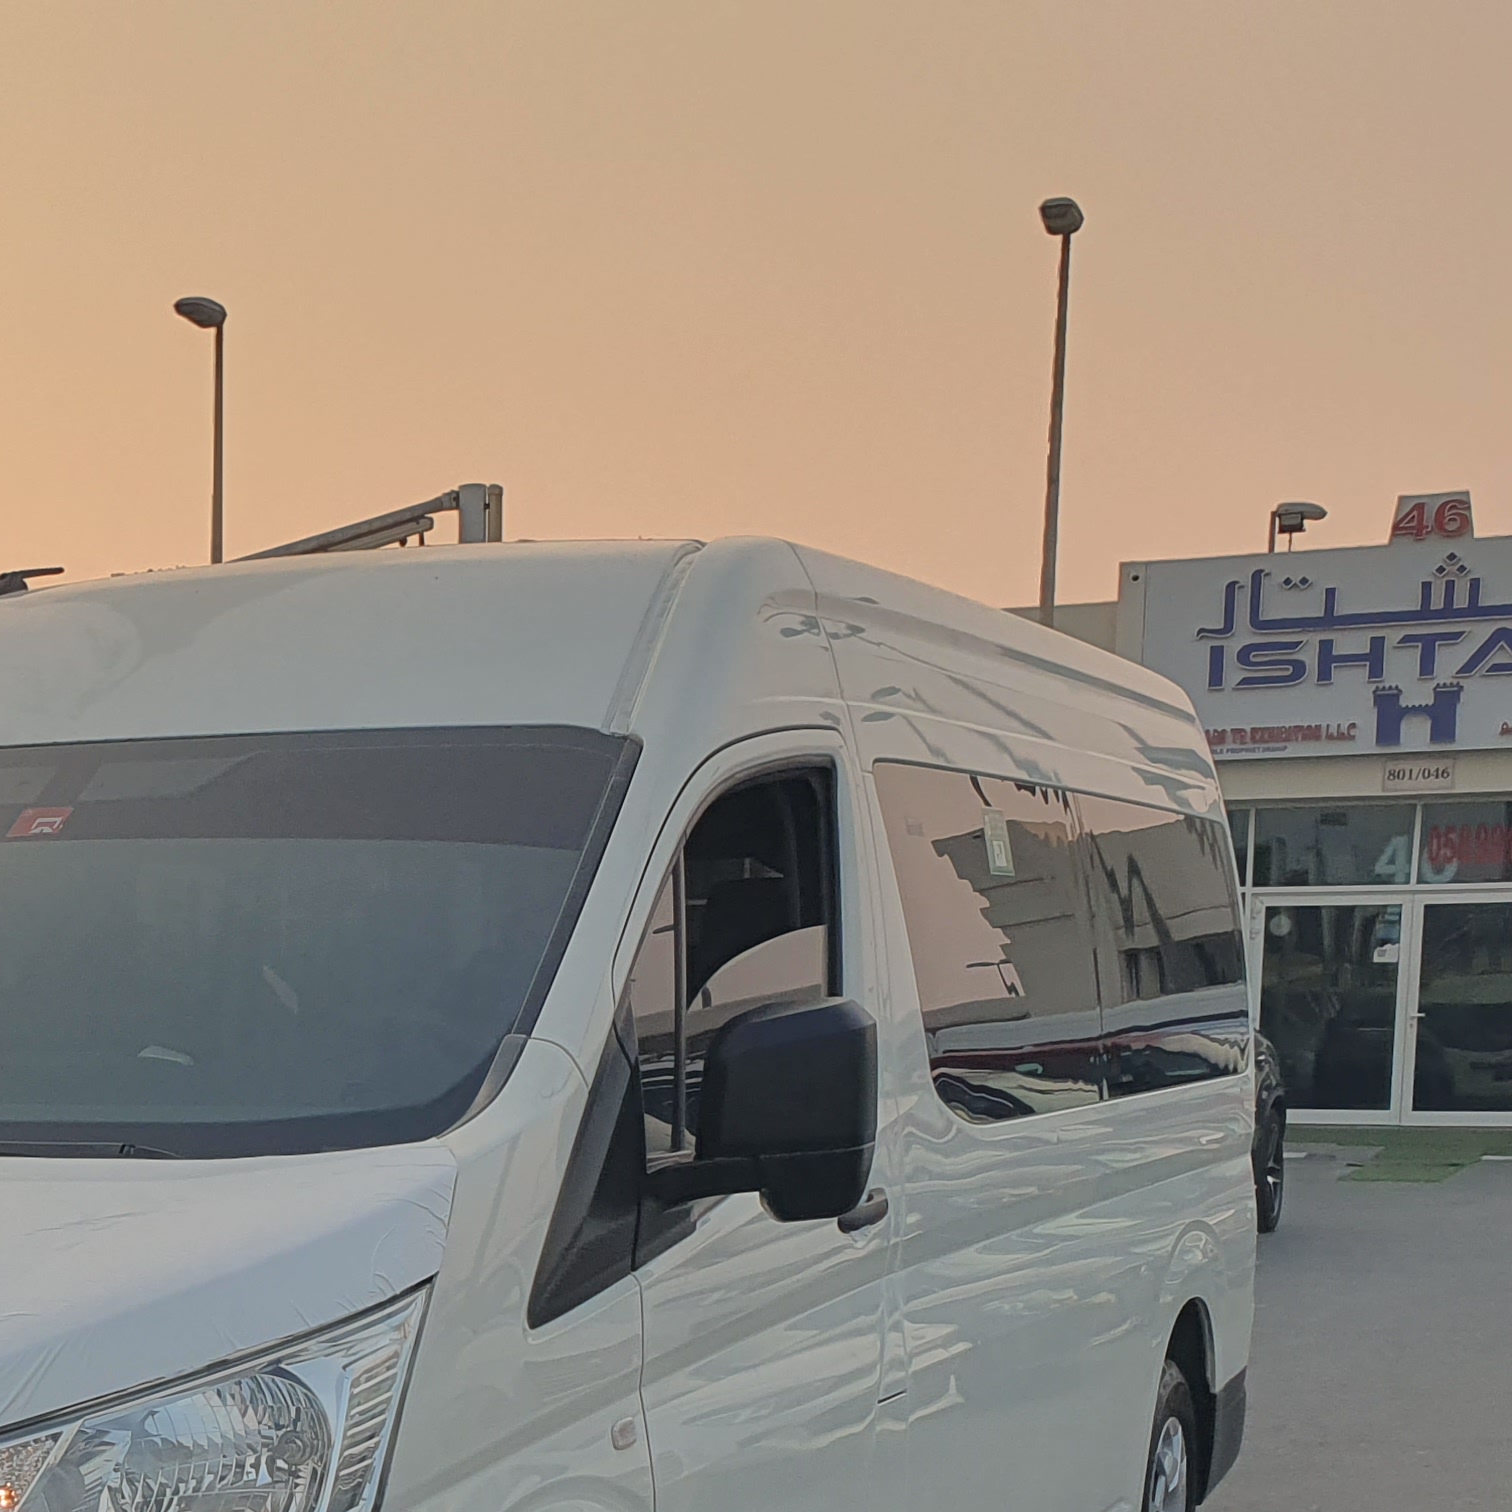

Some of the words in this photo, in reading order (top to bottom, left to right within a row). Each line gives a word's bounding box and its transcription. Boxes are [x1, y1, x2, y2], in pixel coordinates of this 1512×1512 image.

[1392, 499, 1471, 540] 46
[1195, 552, 1512, 641] شتار
[1387, 766, 1451, 782] 801/046
